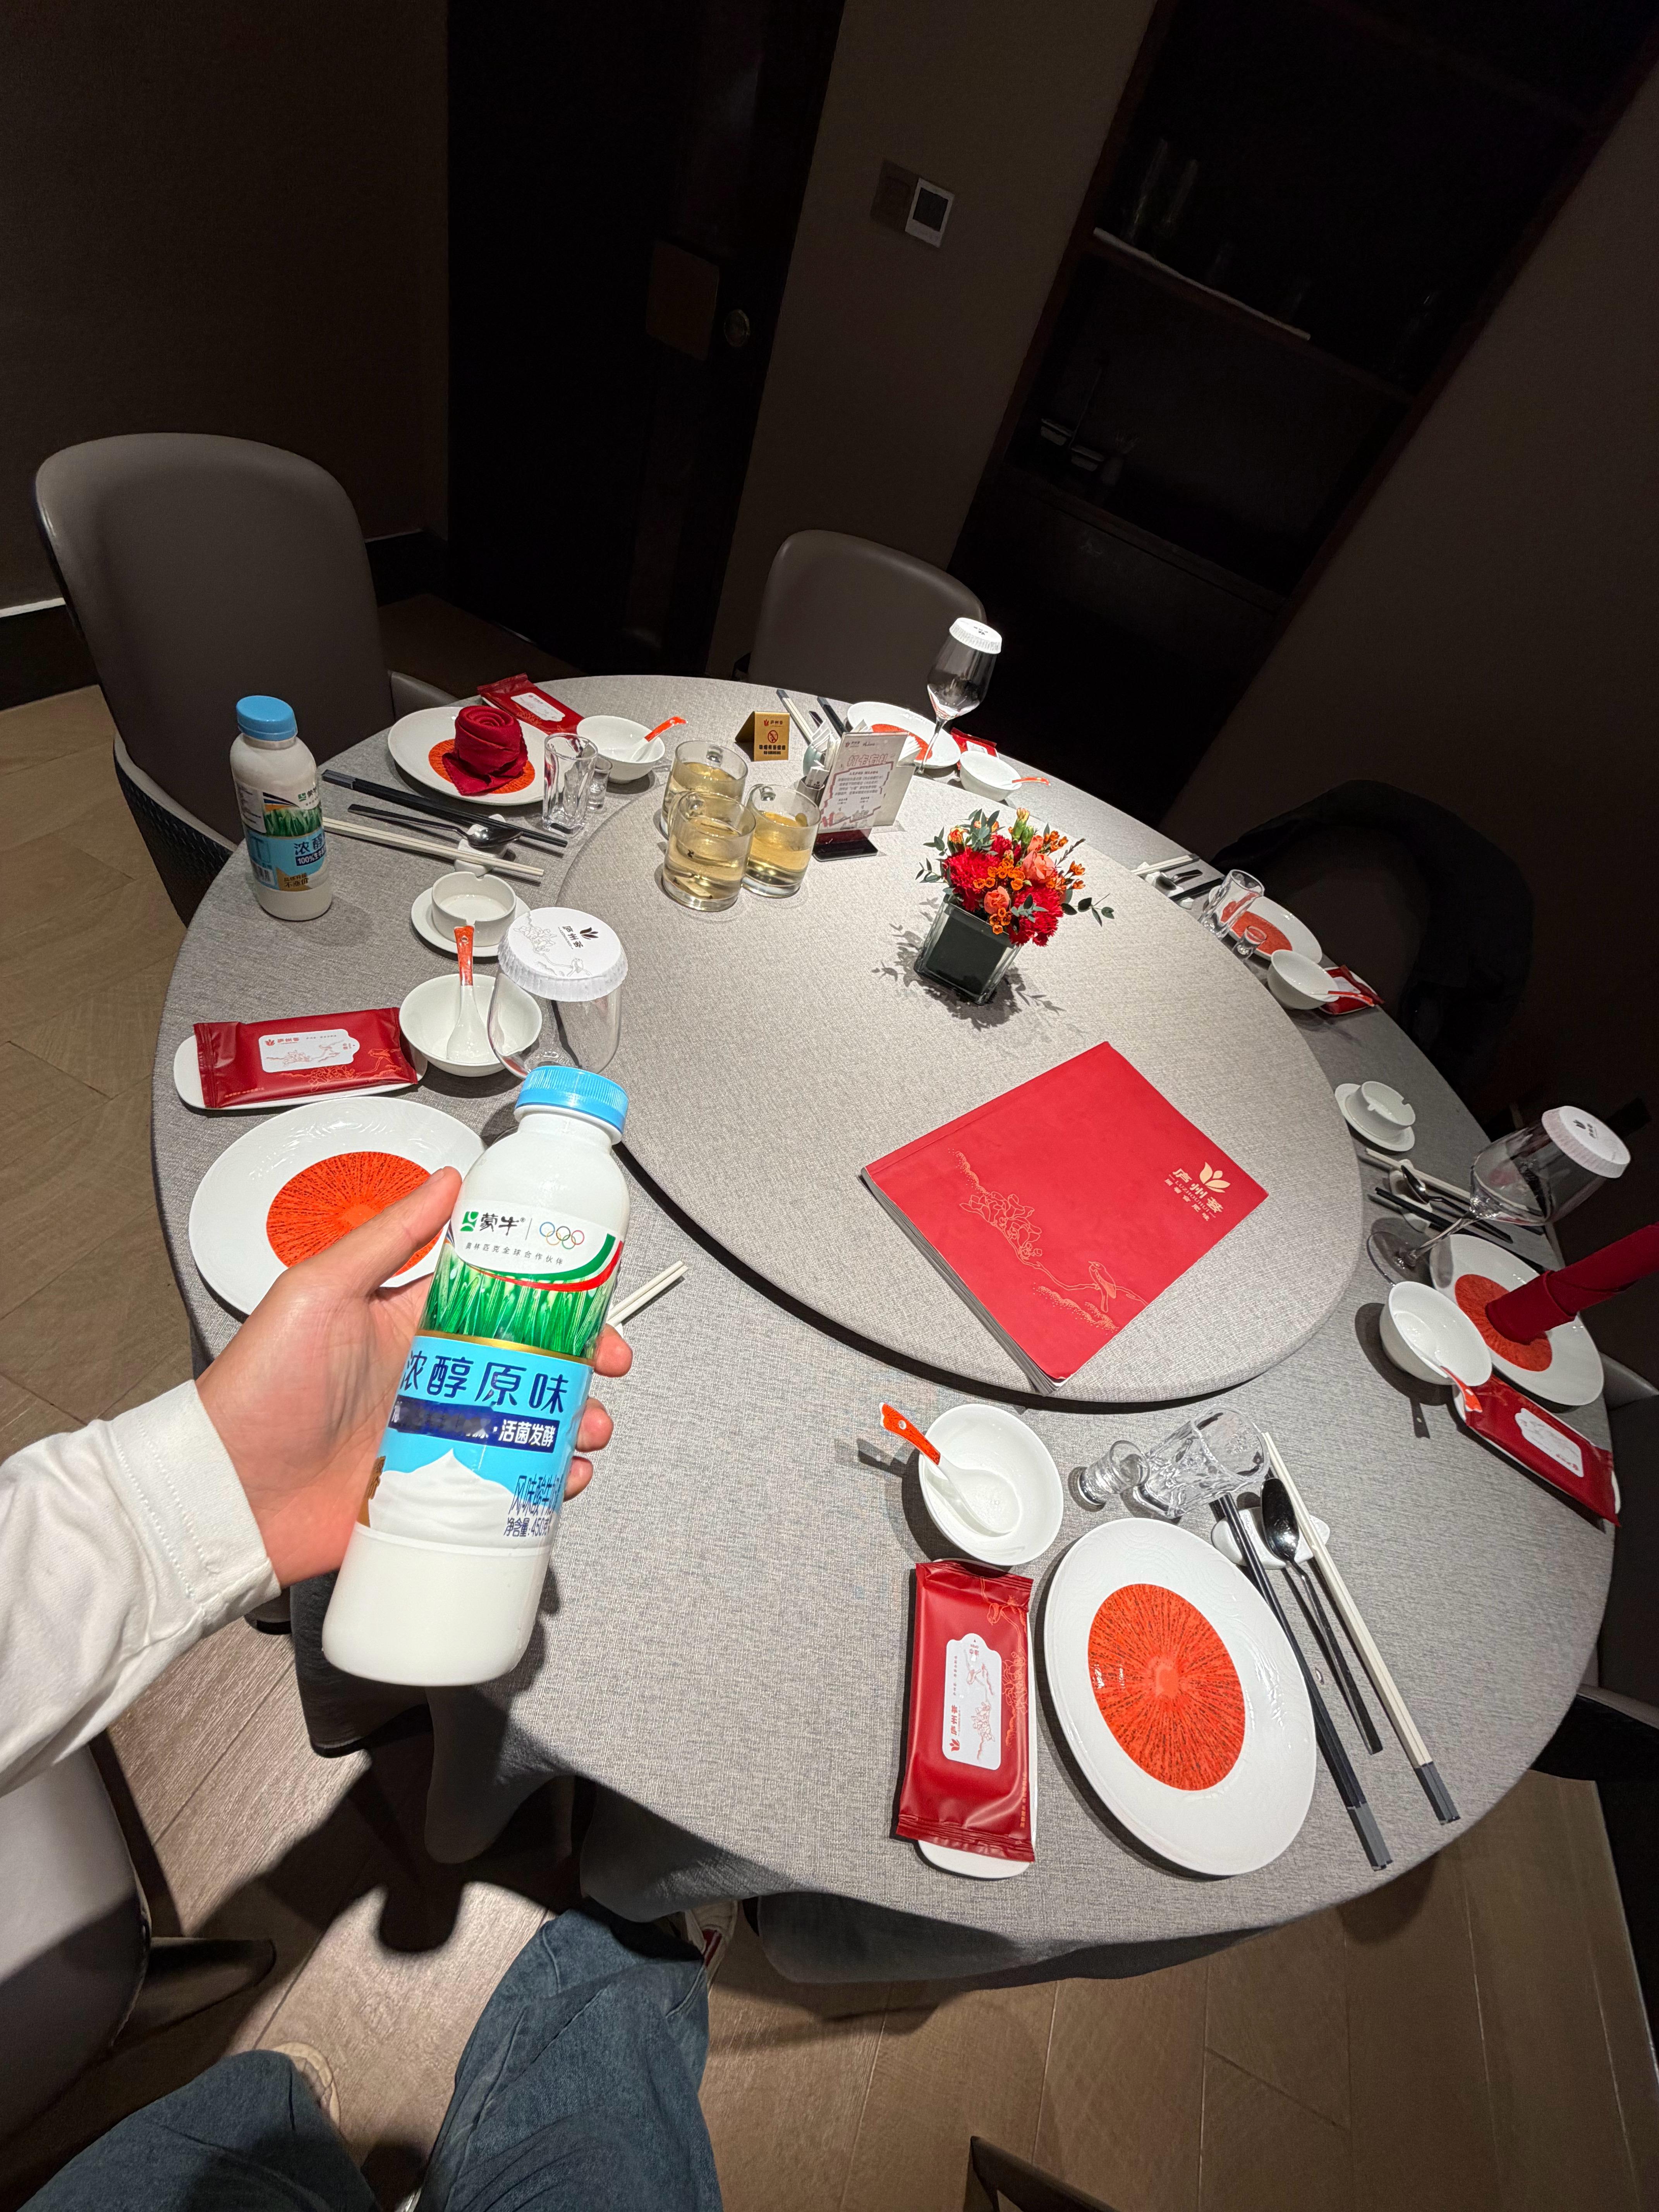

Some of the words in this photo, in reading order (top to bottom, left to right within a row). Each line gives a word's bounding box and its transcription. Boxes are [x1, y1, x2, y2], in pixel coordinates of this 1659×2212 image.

[294, 833, 325, 855] 浓醇
[1173, 1168, 1224, 1213] 庐州荟
[479, 1212, 519, 1236] 蒙牛
[465, 1242, 563, 1265] 奥林匹克全球合作伙伴
[400, 1350, 569, 1414] 浓醇原味
